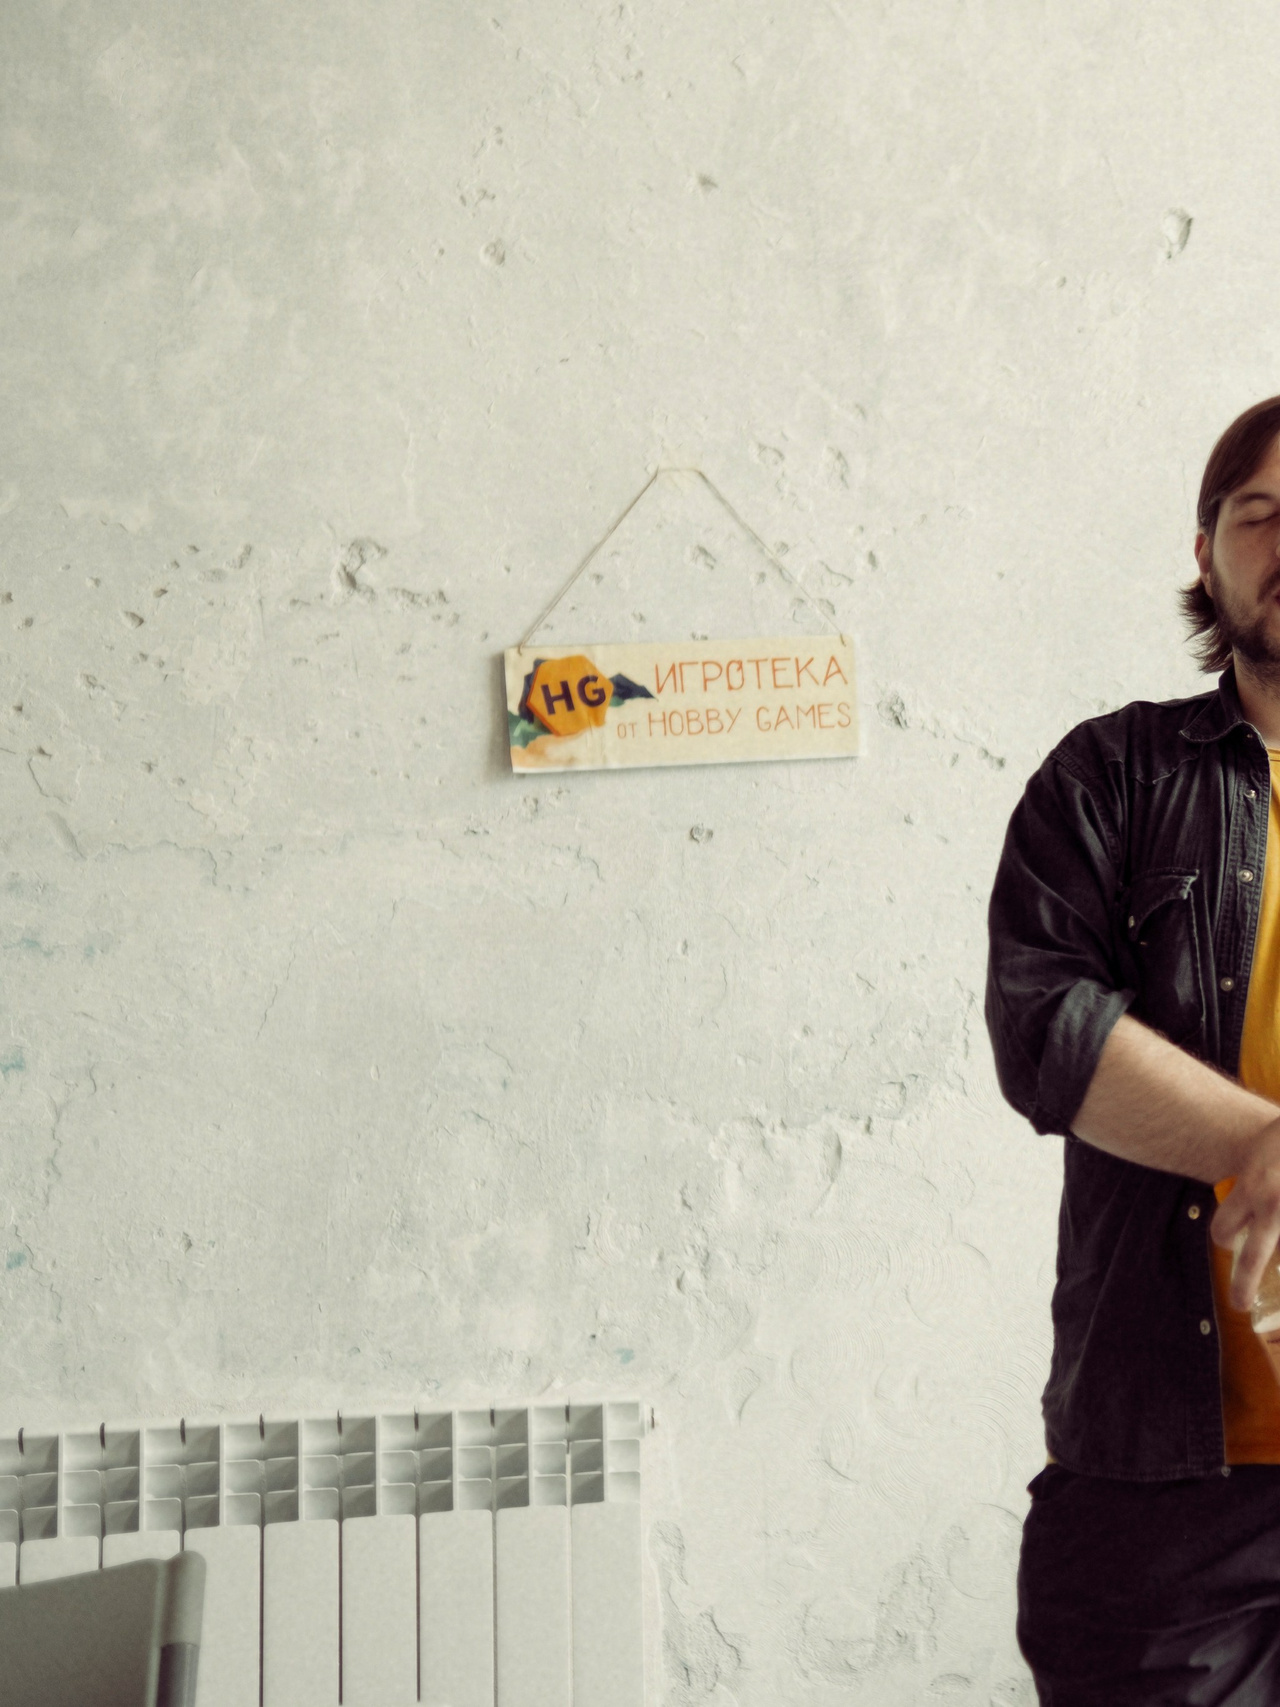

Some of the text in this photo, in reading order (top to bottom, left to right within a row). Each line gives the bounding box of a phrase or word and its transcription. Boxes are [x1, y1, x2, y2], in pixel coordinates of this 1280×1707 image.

[655, 655, 848, 694] ИГРОТЕКА
[540, 675, 606, 715] HG
[648, 708, 742, 737] HOBBY
[756, 703, 851, 732] GAMES
